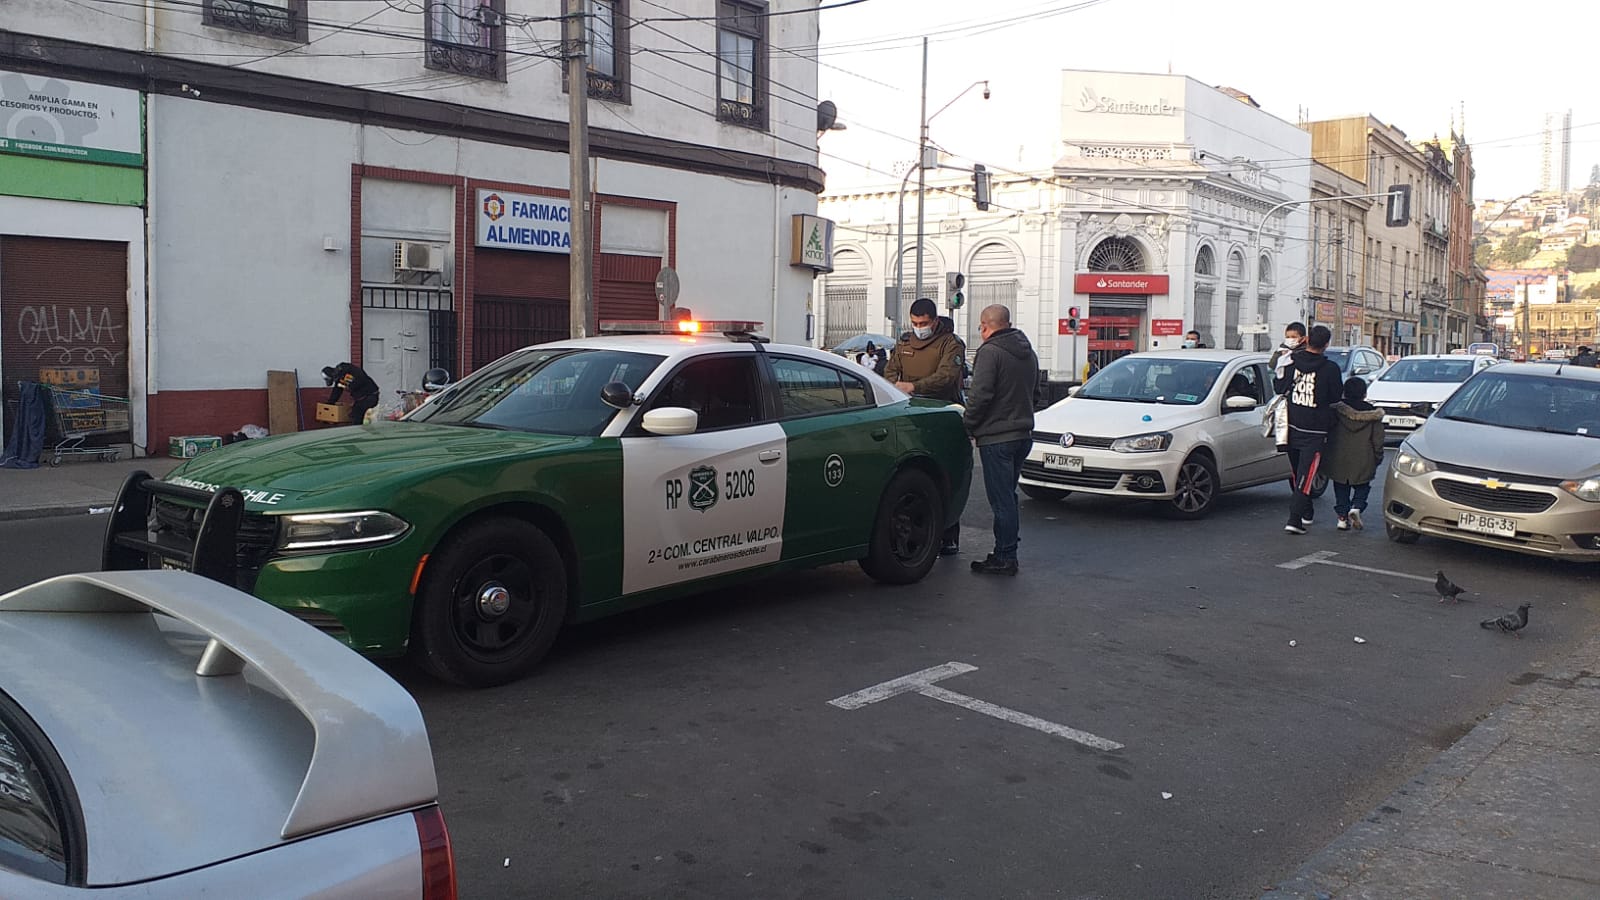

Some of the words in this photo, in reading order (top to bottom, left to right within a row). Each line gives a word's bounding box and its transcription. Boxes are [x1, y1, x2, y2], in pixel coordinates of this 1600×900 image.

[29, 93, 60, 105] AMPLIA
[61, 98, 86, 108] GAMA
[87, 102, 98, 110] EN
[42, 105, 48, 113] Y
[49, 107, 101, 119] PRODUCTOS.
[486, 225, 571, 249] ALMENDRA
[1107, 279, 1149, 289] Santander
[828, 469, 841, 481] 133
[666, 479, 682, 510] RP
[725, 468, 755, 500] 5208
[664, 542, 691, 561] COM.
[693, 532, 743, 554] CENTRAL
[746, 526, 780, 543] VALPO.
